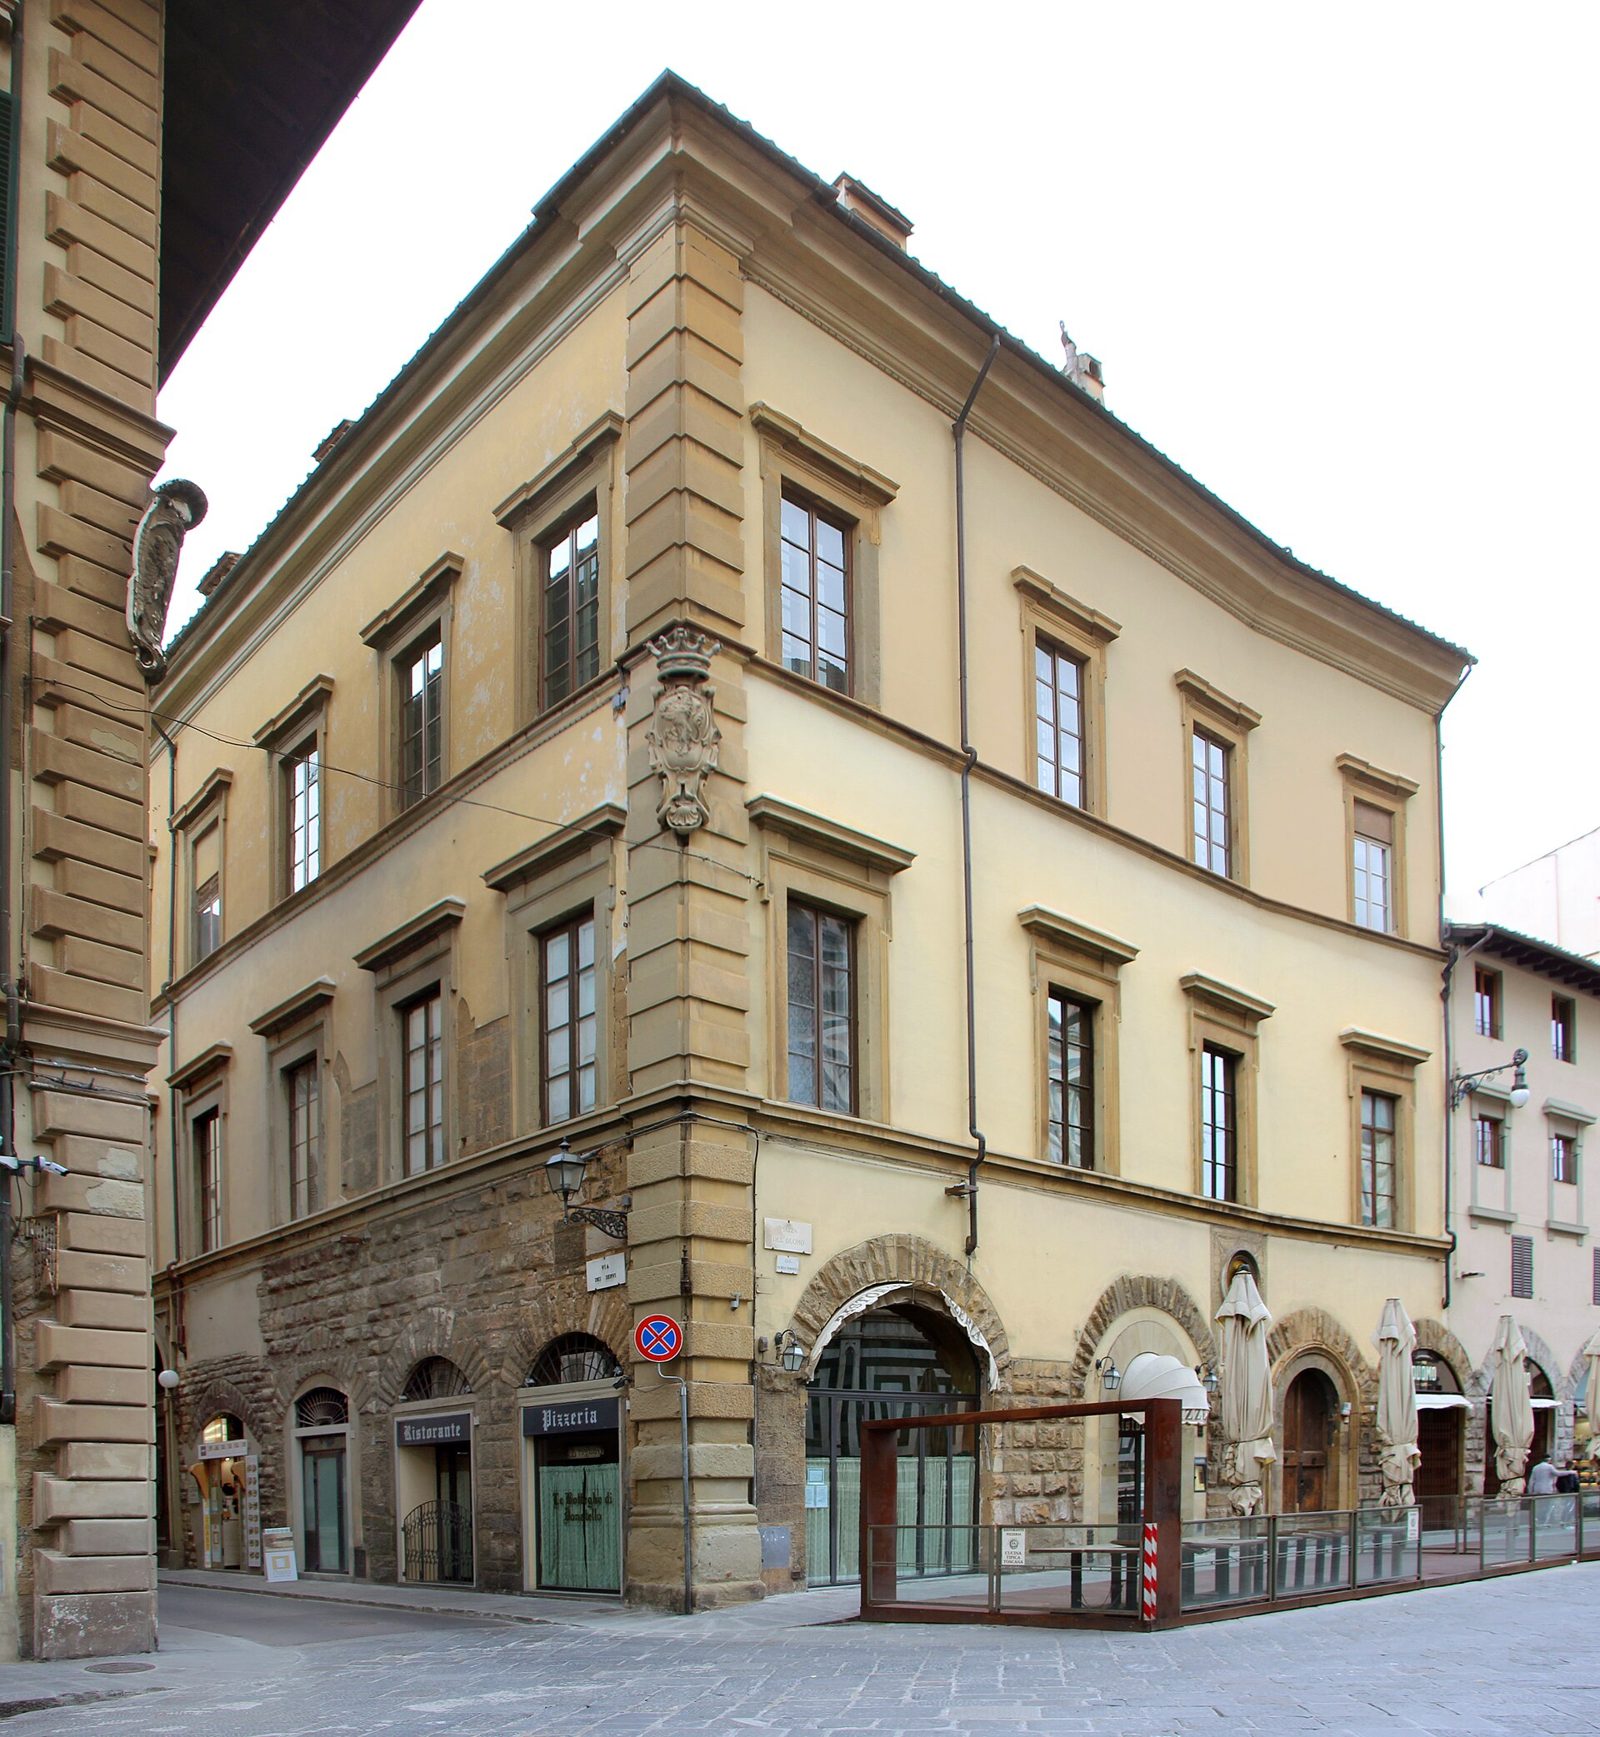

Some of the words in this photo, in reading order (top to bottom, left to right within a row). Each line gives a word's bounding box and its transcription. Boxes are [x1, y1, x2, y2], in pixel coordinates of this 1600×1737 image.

[605, 1272, 617, 1280] SERVI
[542, 1407, 598, 1431] Pizzeria
[403, 1424, 461, 1441] Ristorante
